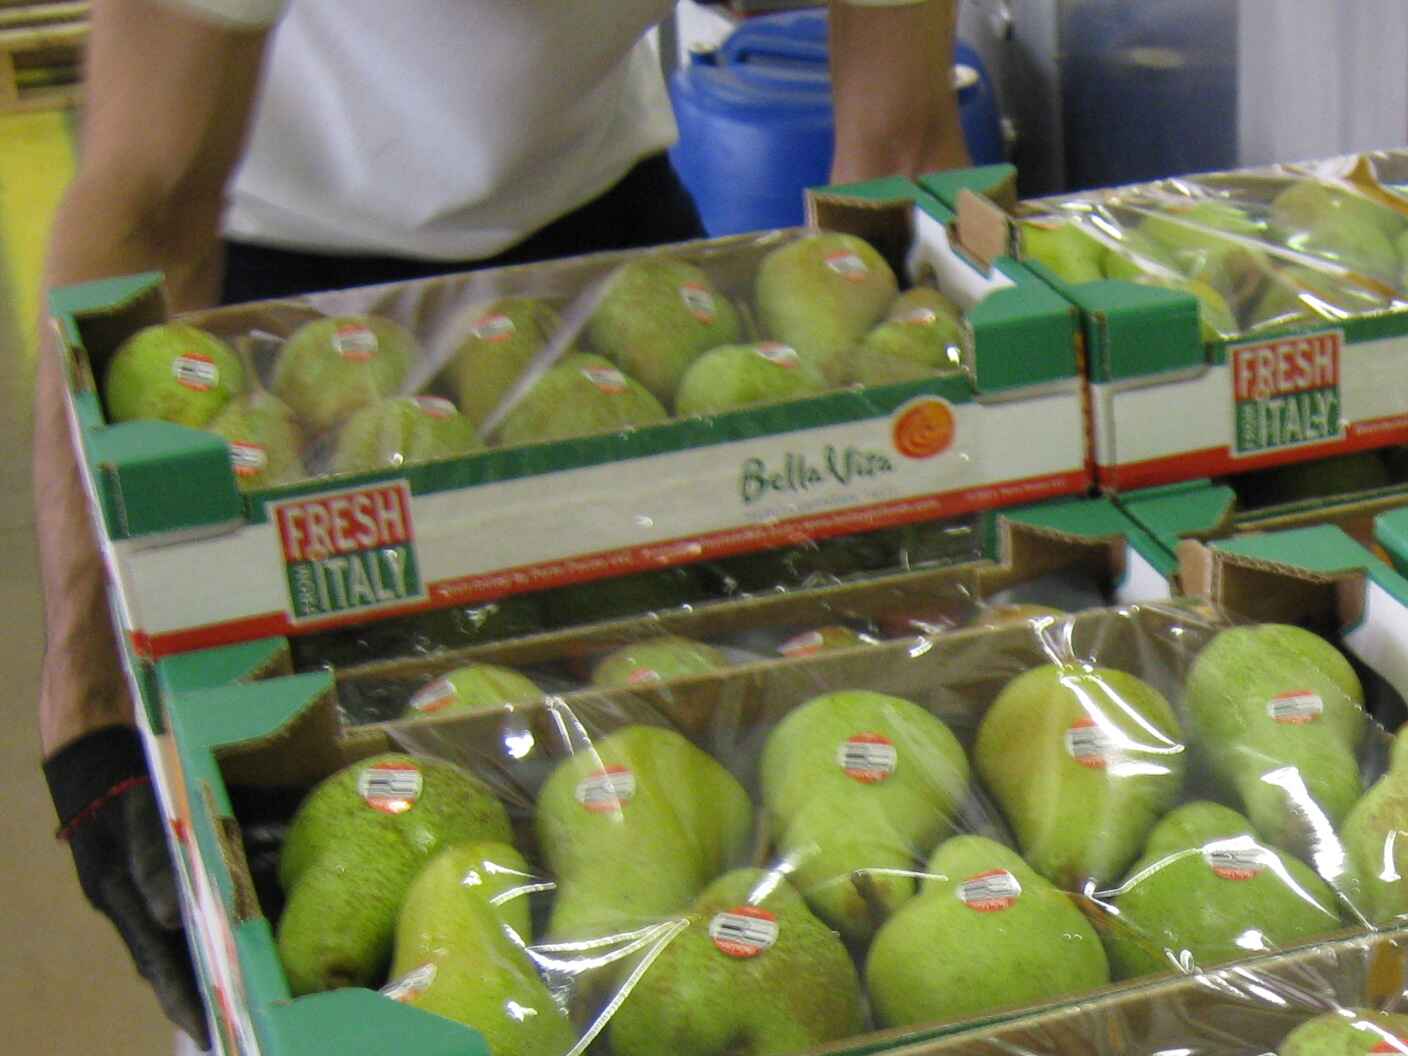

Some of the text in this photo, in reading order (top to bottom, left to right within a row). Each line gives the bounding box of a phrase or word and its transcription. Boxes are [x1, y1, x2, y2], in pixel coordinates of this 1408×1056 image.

[1239, 338, 1334, 400] FRESH
[1255, 389, 1334, 448] ITALY
[741, 452, 823, 504] Bella
[825, 444, 894, 485] Vita
[285, 489, 406, 561] FRESH
[312, 546, 408, 612] ITALY
